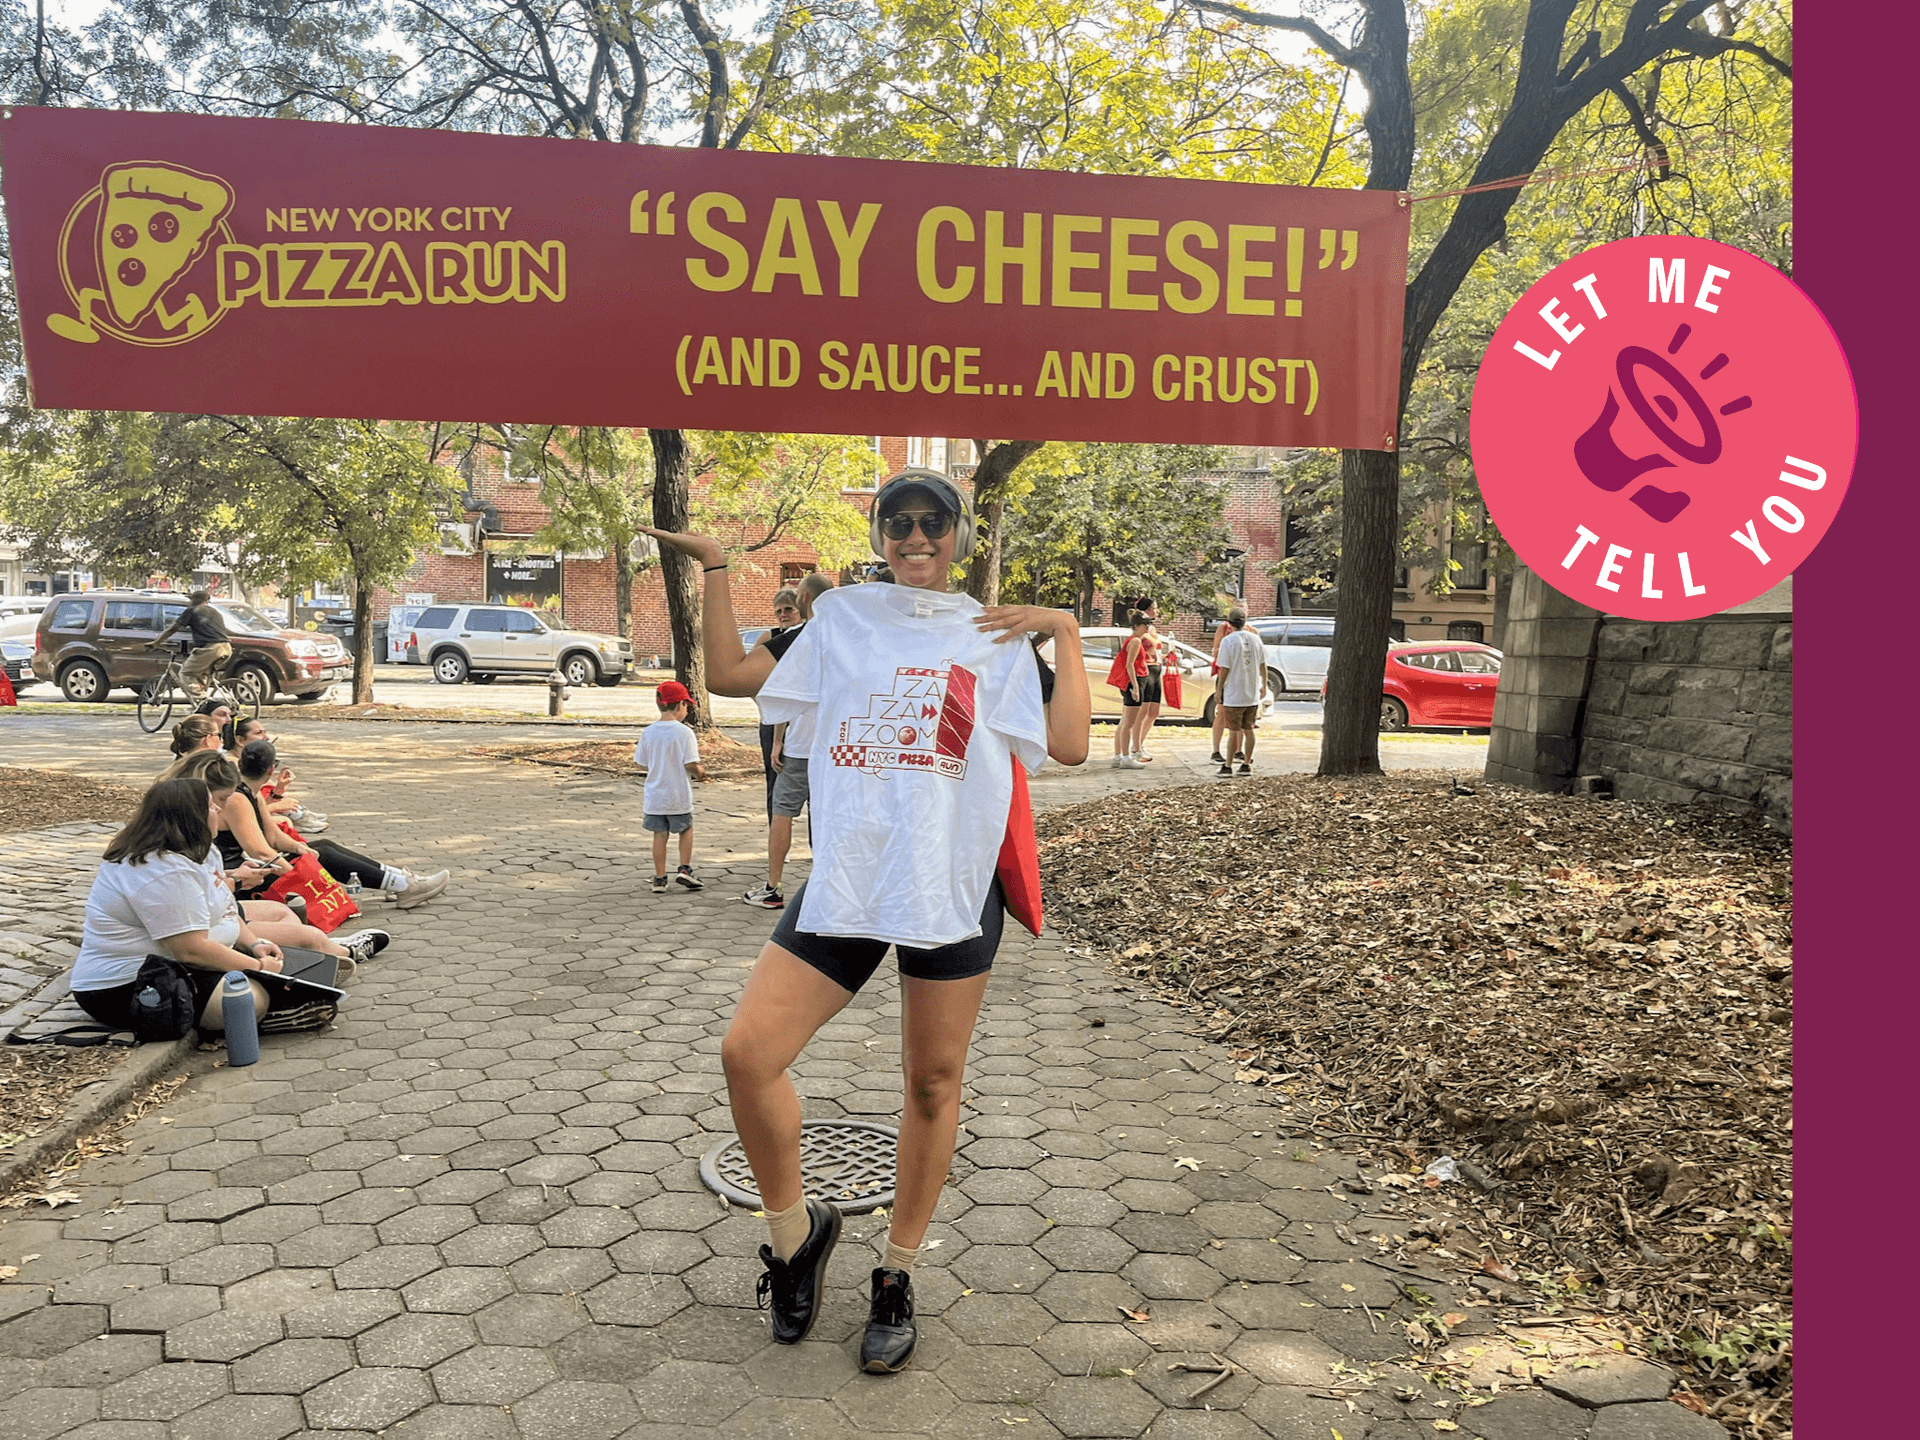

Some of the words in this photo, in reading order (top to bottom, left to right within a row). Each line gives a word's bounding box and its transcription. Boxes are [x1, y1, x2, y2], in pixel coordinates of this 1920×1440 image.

[265, 207, 339, 233] NEW
[346, 207, 435, 232] YORK
[440, 206, 513, 232] CITY
[216, 241, 422, 309] PIZZA
[425, 239, 566, 304] RUN
[675, 335, 801, 396] (AND
[818, 338, 1024, 397] SAUCE...
[1034, 351, 1136, 400] AND
[1151, 354, 1321, 416] CRUST)
[903, 679, 942, 701] ZA
[879, 700, 919, 721] ZA
[839, 721, 847, 743] 2024
[868, 751, 897, 764] NYC
[898, 753, 934, 766] PIZZA
[940, 761, 959, 772] RUN
[305, 880, 323, 899] I
[317, 886, 348, 913] NY
